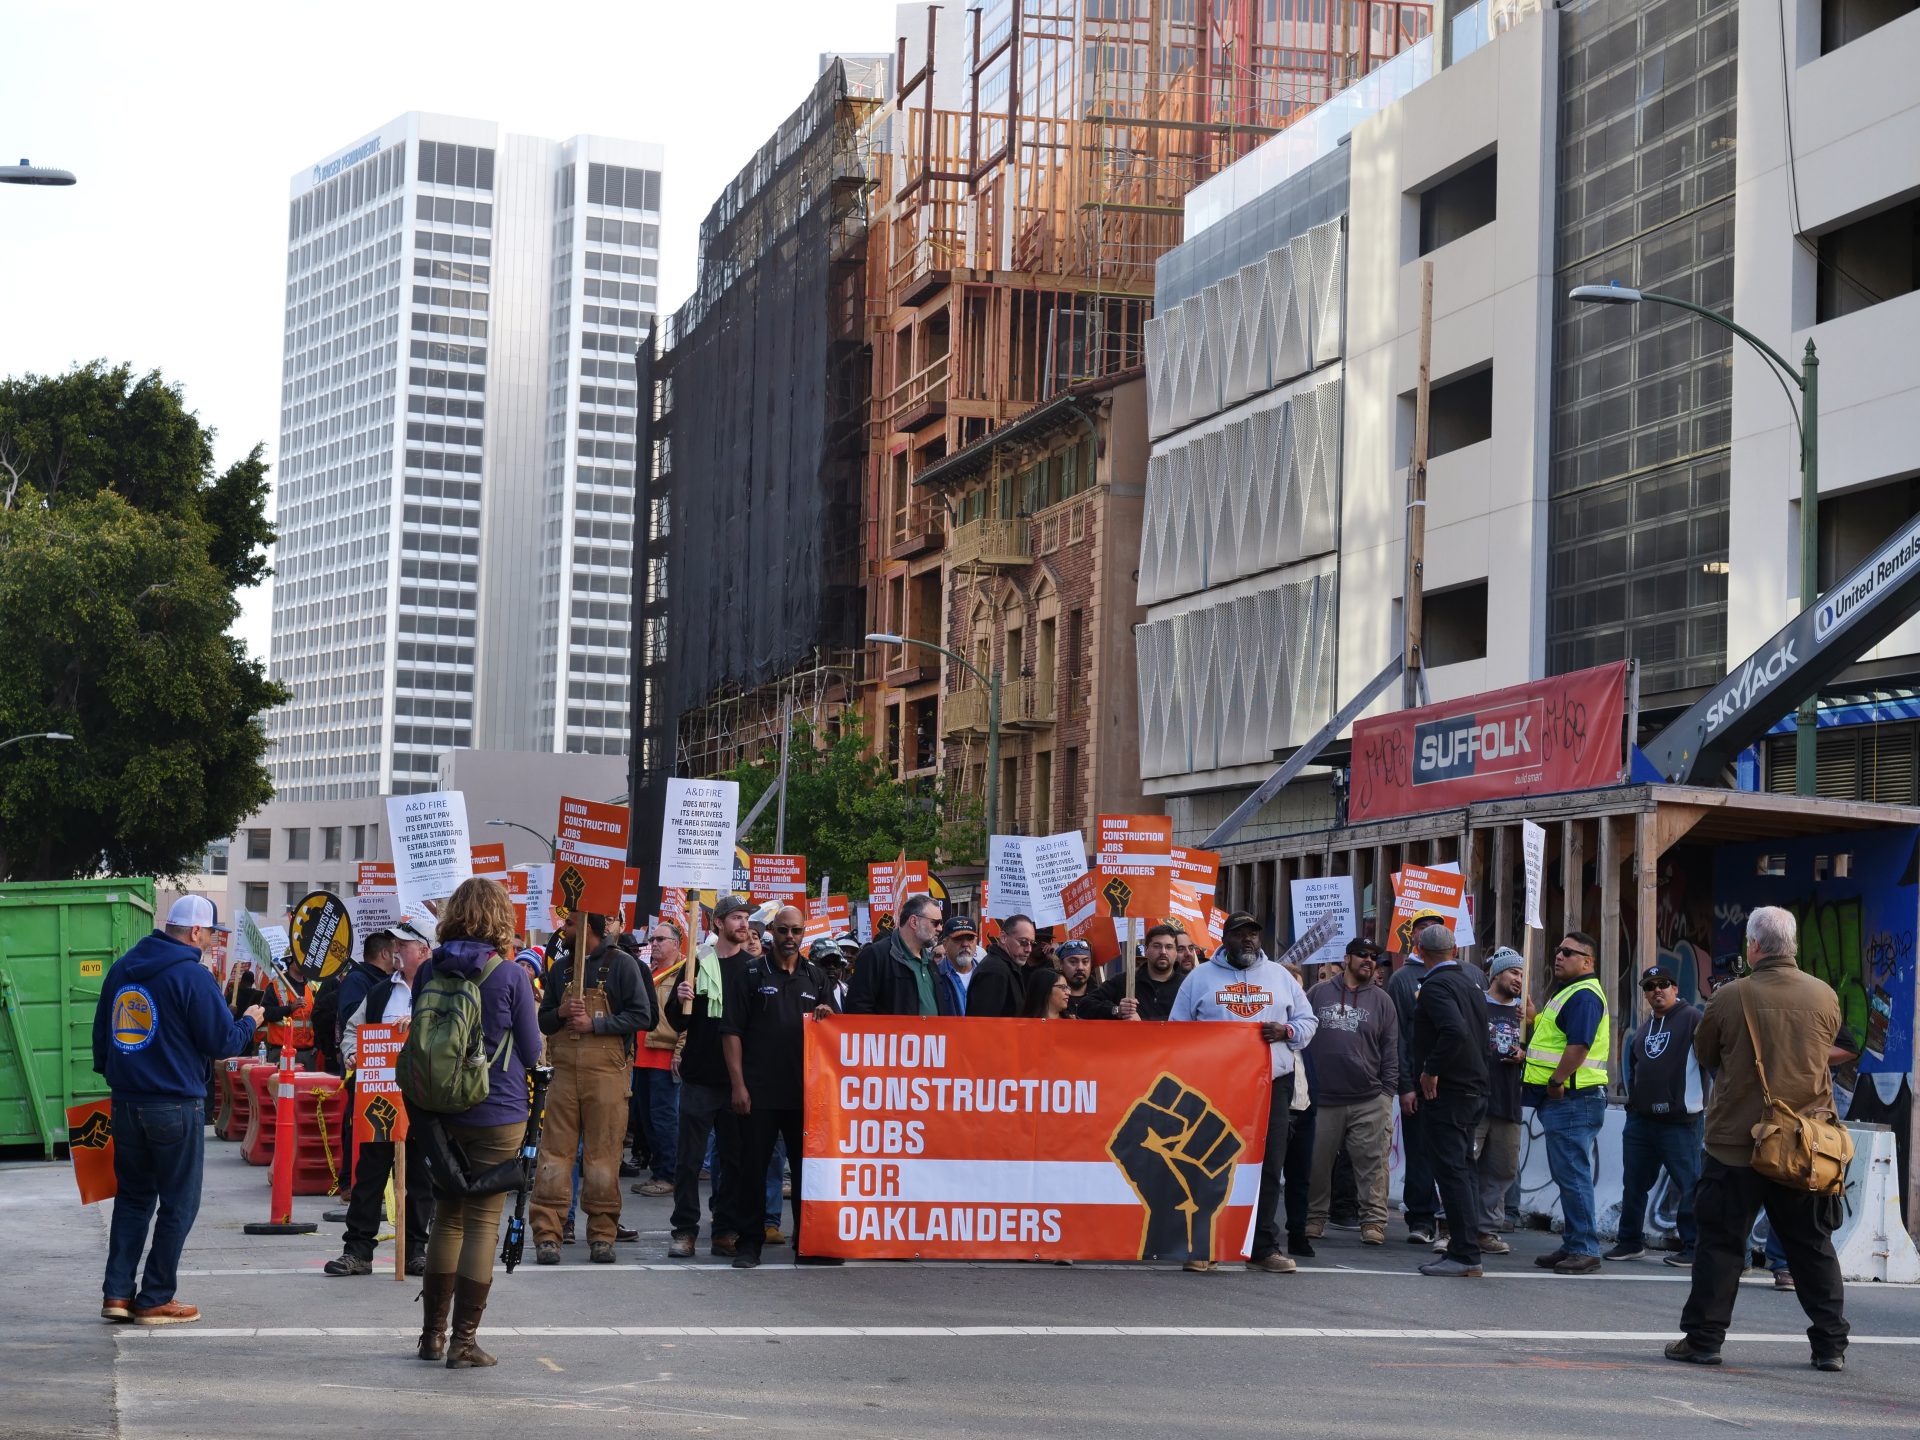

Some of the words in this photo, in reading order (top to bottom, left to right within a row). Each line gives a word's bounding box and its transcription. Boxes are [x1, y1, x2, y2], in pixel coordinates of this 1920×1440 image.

[1836, 572, 1874, 619] United
[1877, 537, 1920, 587] Rentals
[1706, 638, 1798, 733] SKYJACK
[1420, 716, 1532, 771] SUFFOLK
[686, 788, 704, 797] A&D
[706, 789, 722, 797] FIRE
[406, 802, 426, 812] A&D
[429, 800, 447, 809] FIRE
[565, 803, 587, 815] UNION
[417, 821, 453, 830] EMPLOYEES
[564, 815, 621, 833] CONSTRUCTION
[1103, 820, 1128, 828] UNION
[430, 830, 462, 838] STANDARD
[563, 828, 581, 839] JOBS
[1103, 832, 1164, 841] CONSTRUCTION
[407, 840, 448, 851] ESTABLISHED
[562, 840, 574, 850] FOR
[1102, 843, 1123, 852] JOBS
[425, 850, 442, 858] AREA
[1102, 855, 1117, 863] FOR
[411, 860, 437, 869] SIMILAR
[471, 856, 499, 864] TRUCTION
[560, 852, 610, 869] OAKLANDERS
[1102, 866, 1155, 876] OAKLANDERS
[1406, 868, 1428, 880] UNION
[772, 874, 791, 882] UNIÓN
[873, 875, 922, 884] CONSTTION
[1404, 879, 1456, 896] CONSTRUCTION
[1402, 889, 1420, 899] JOBS
[1400, 899, 1414, 908] FOR
[304, 952, 314, 968] THE
[315, 914, 330, 938] FIGHTS
[324, 901, 334, 917] FOR
[314, 937, 330, 968] WORKING
[324, 913, 339, 939] PEOPLE
[128, 1001, 148, 1013] 342
[1232, 1004, 1259, 1015] CYCLES
[362, 1030, 390, 1040] UNION
[840, 1033, 946, 1068] UNION
[363, 1056, 386, 1067] JOBS
[363, 1070, 380, 1080] FOR
[363, 1082, 401, 1093] OAKLAN
[840, 1076, 1097, 1114] CONSTRUCTION
[839, 1119, 925, 1154] JOBS
[840, 1163, 900, 1197] FOR
[838, 1206, 1061, 1243] OAKLANDERS
